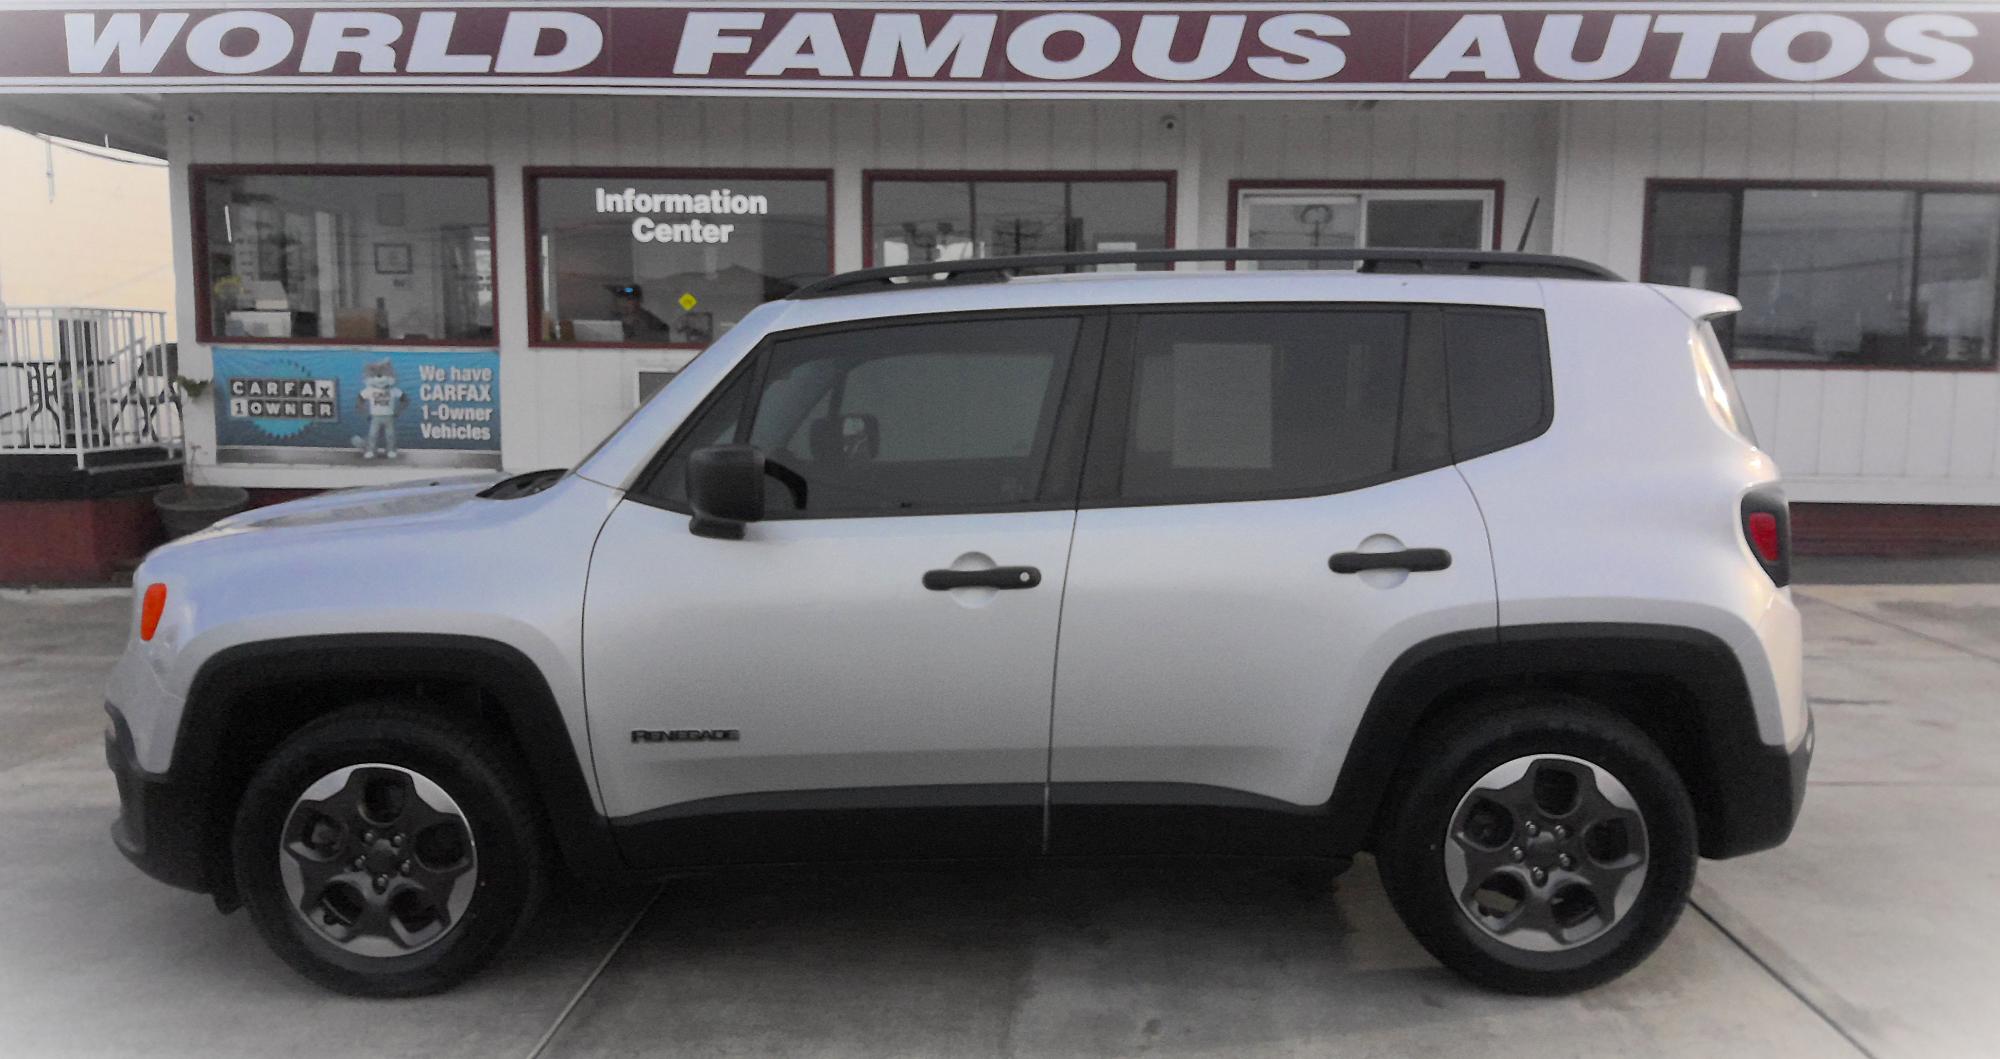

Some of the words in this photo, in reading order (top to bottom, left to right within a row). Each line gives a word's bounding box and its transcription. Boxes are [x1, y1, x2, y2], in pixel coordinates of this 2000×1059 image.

[64, 11, 604, 74] WORLD
[672, 12, 1350, 81] FAMOUS
[1409, 13, 1979, 82] AUTOS
[595, 187, 768, 214] Information
[631, 216, 735, 243] Center
[419, 365, 445, 381] We
[450, 365, 492, 382] have
[231, 381, 333, 399] CARFAX
[419, 383, 492, 402] CARFAX
[250, 403, 334, 417] OWNER
[421, 404, 492, 422] 1-Owner
[420, 423, 491, 441] Vehicles
[631, 730, 740, 743] RENEGADE
